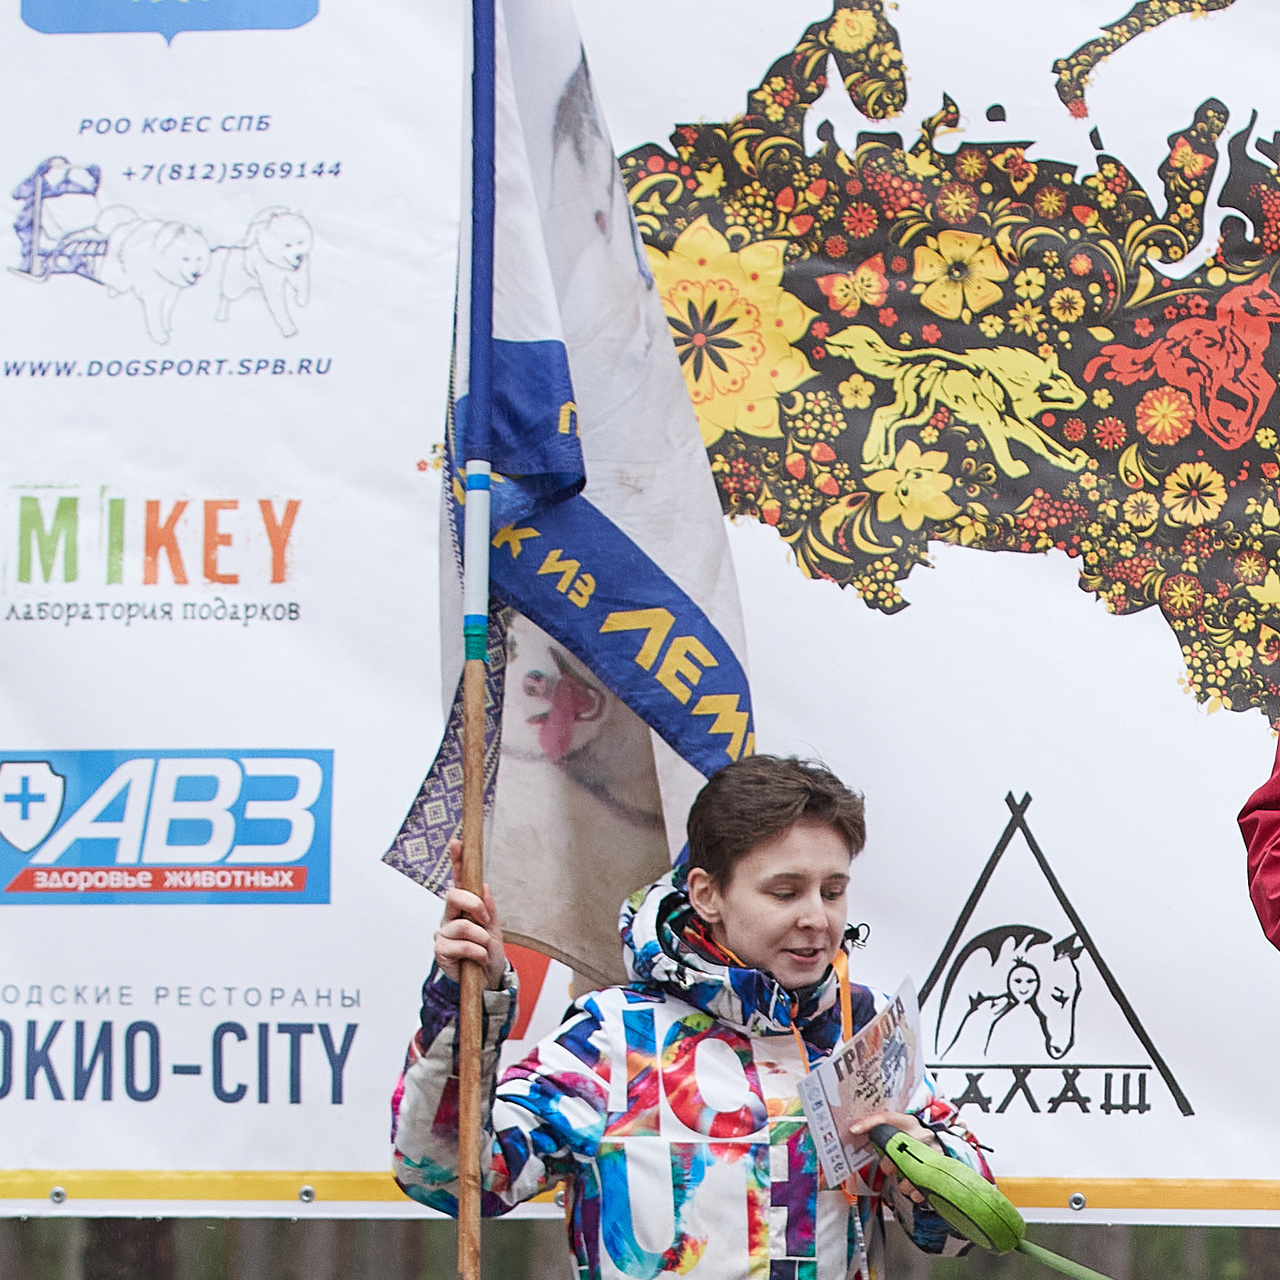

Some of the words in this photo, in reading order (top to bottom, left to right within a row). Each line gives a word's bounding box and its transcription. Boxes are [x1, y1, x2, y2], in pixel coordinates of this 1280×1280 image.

[78, 117, 132, 135] РОО
[141, 116, 211, 134] КФЕС
[221, 114, 271, 132] СПБ
[121, 161, 343, 185] +7(812)5969144
[3, 357, 334, 378] WWW.DOGSPORT.SPB.RU
[17, 496, 302, 586] MIKEY
[182, 596, 301, 627] подарков
[29, 757, 324, 865] АВЗ
[154, 986, 362, 1008] РЕСТОРАНЫ
[832, 995, 905, 1082] ГРАМОТА
[931, 1066, 1151, 1115] АЛАШ
